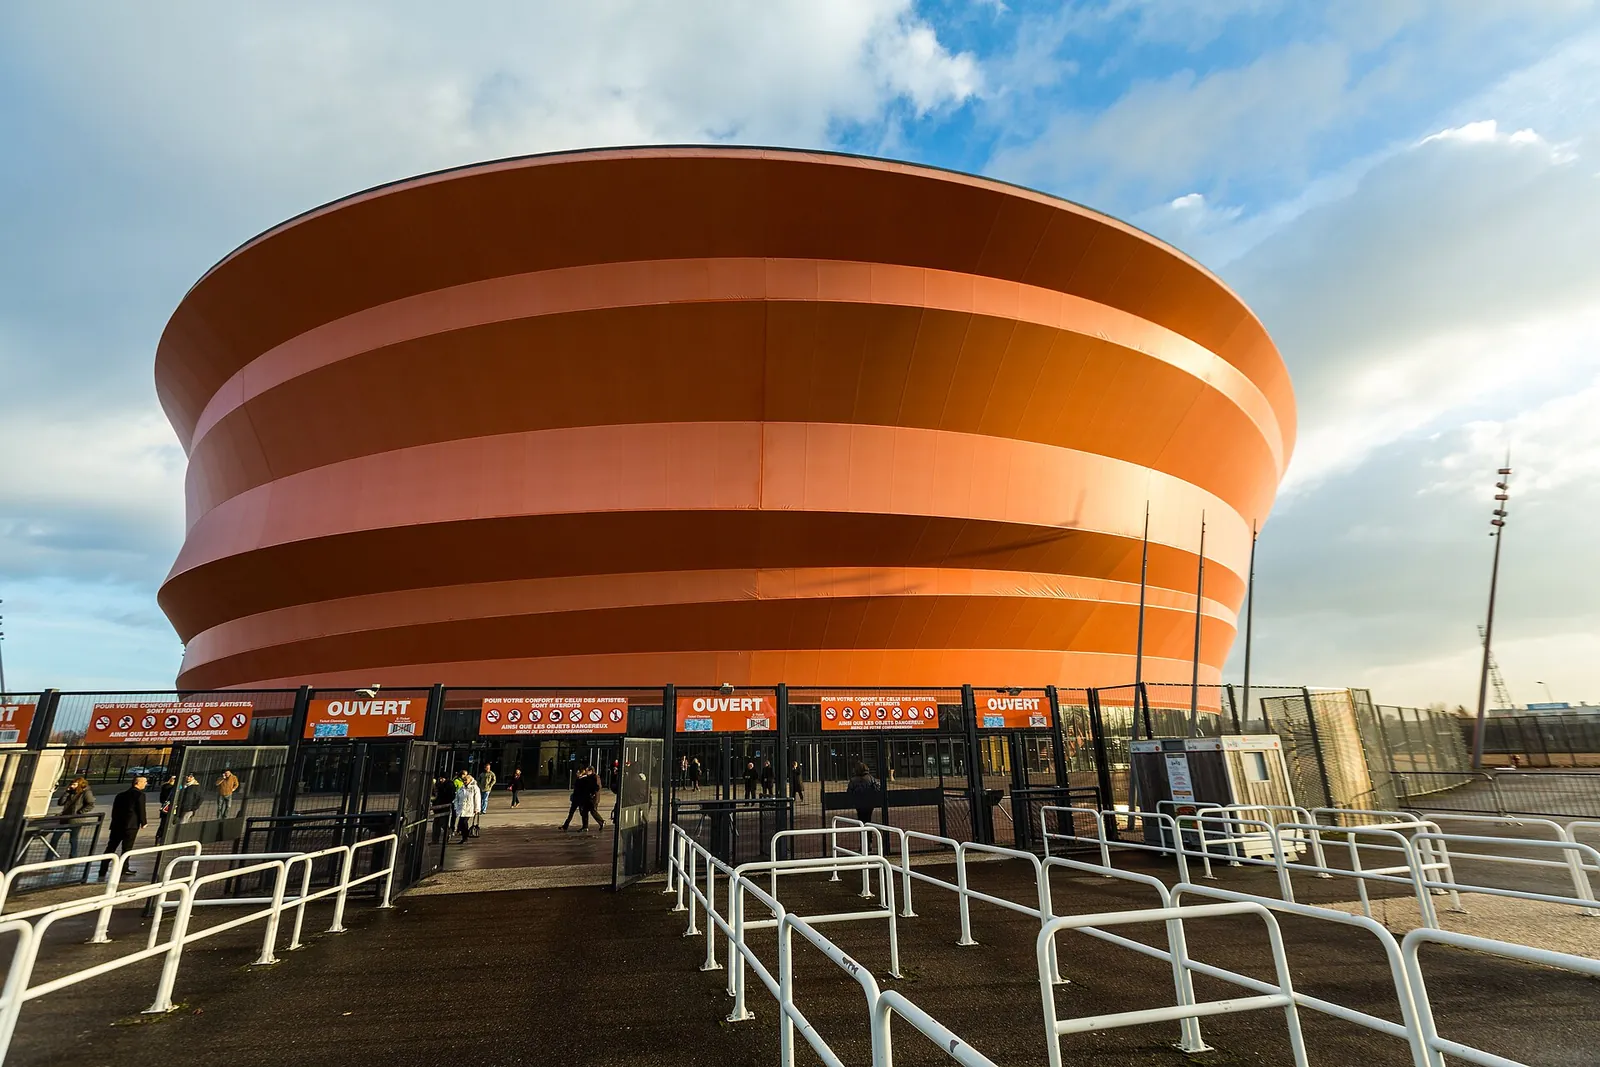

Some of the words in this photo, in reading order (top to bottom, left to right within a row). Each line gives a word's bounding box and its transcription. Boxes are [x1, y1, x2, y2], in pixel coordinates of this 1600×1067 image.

[327, 700, 411, 716] OUVERT
[692, 698, 763, 712] OUVERT
[987, 698, 1040, 710] OUVERT
